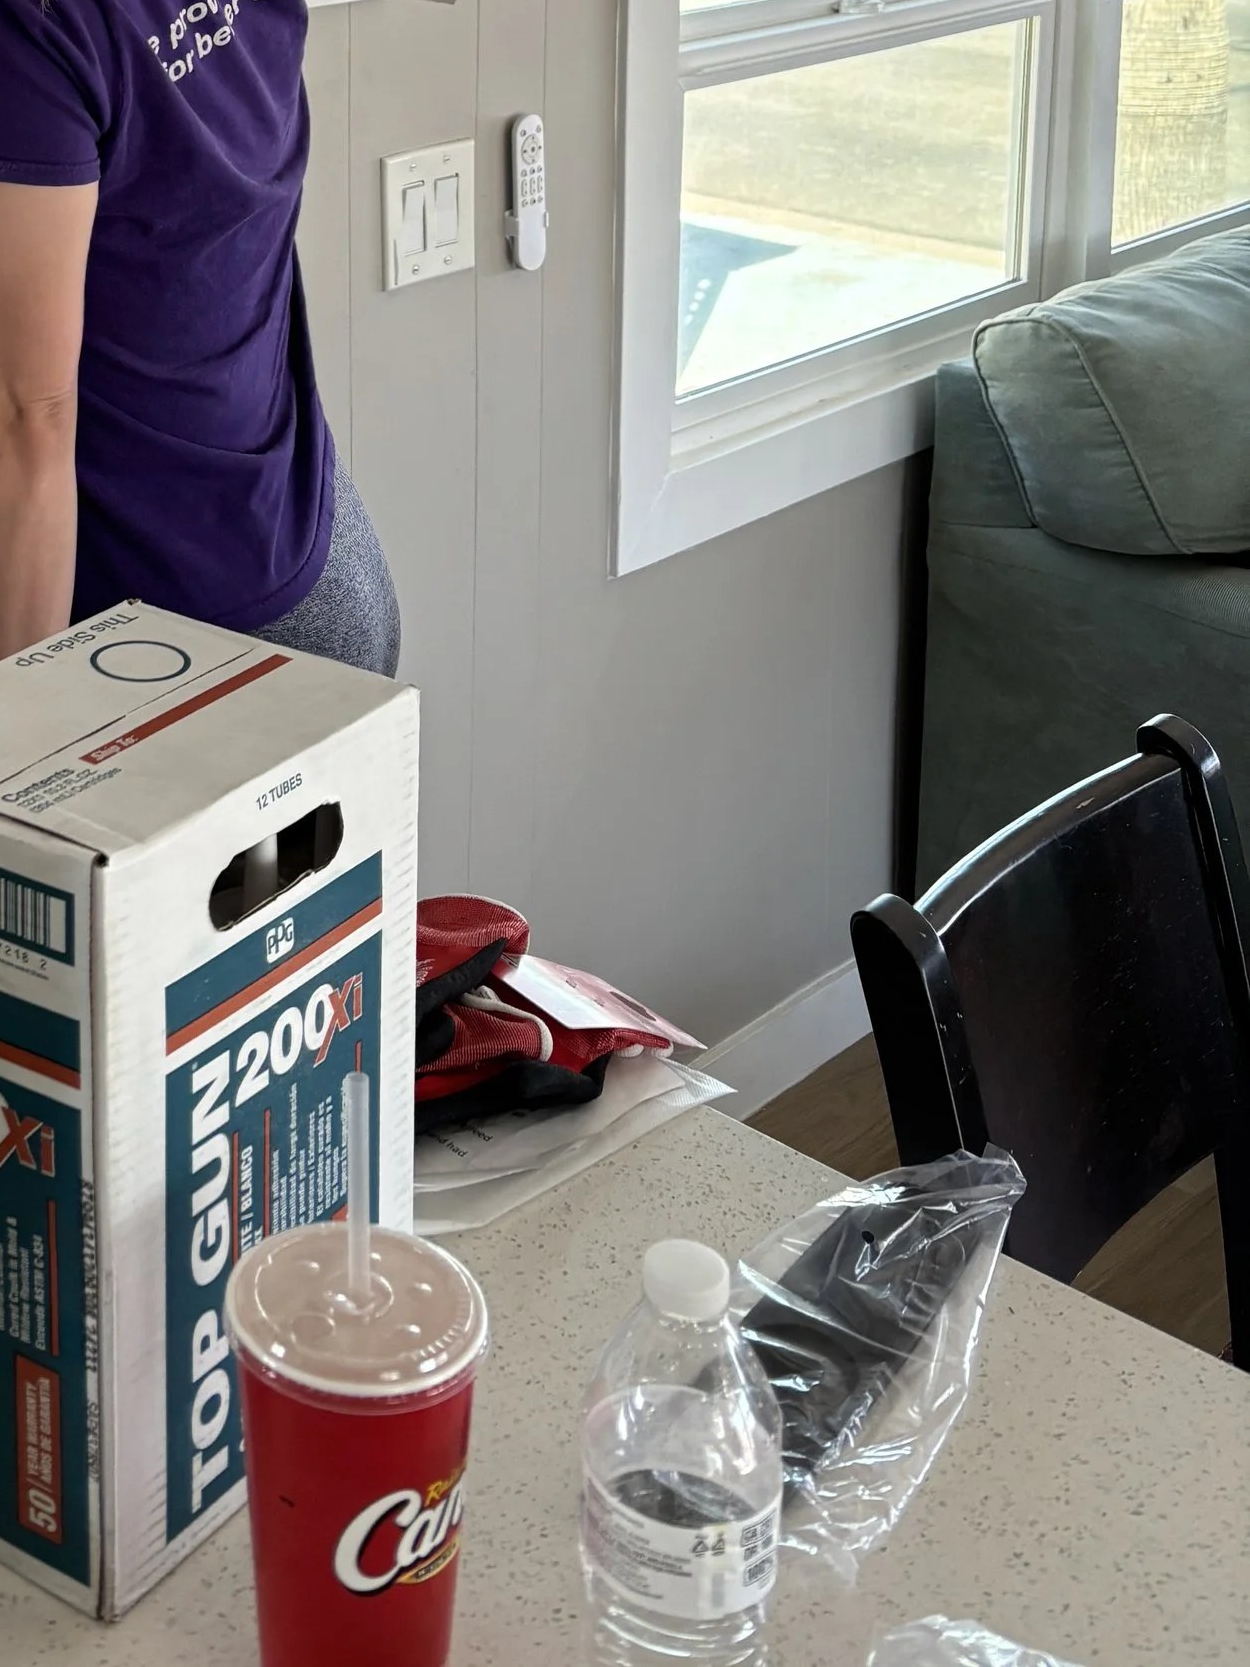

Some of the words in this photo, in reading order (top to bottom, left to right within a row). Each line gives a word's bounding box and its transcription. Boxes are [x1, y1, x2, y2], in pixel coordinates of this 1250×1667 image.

[89, 614, 139, 632] This
[47, 632, 96, 652] Side
[15, 652, 54, 667] Up
[1, 768, 75, 802] Contents
[255, 794, 269, 810] 12
[268, 772, 302, 802] TUBES
[267, 921, 293, 955] PPG
[39, 958, 46, 971] 2
[191, 1049, 231, 1287] GUN
[240, 1144, 253, 1213] BLANCO
[241, 1221, 253, 1253] ITE
[191, 1308, 231, 1514] TOP
[28, 1489, 57, 1533] 50
